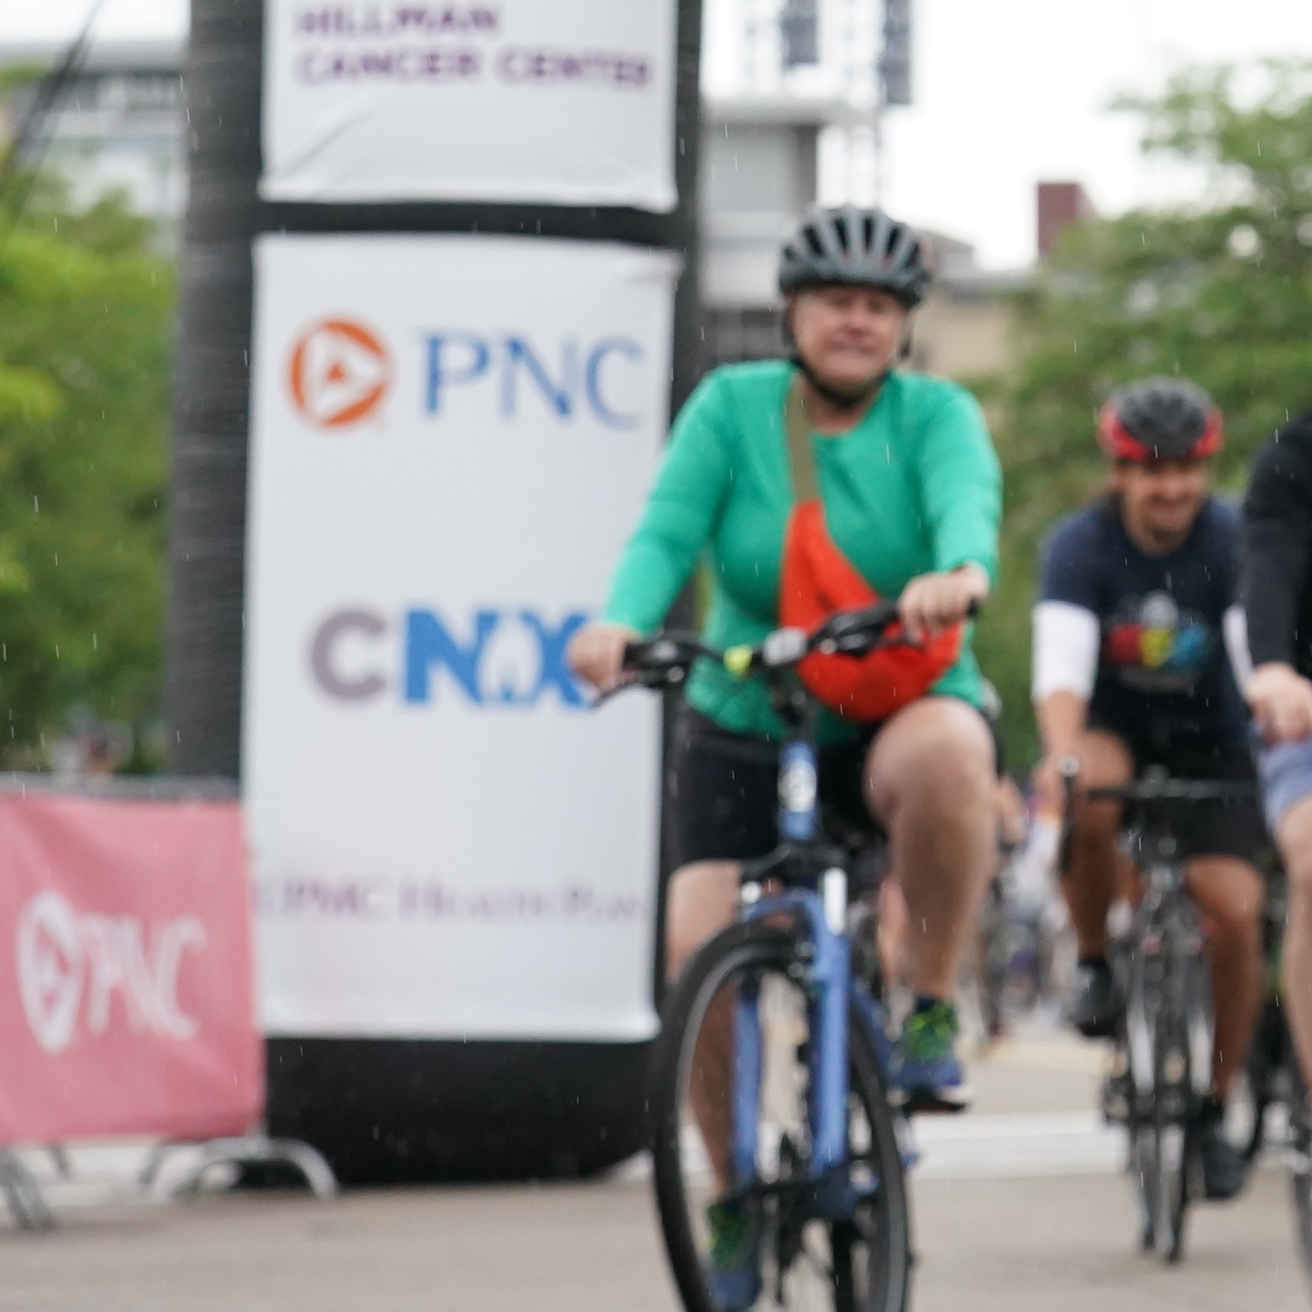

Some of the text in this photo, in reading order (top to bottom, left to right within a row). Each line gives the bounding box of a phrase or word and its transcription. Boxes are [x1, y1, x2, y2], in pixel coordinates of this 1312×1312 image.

[296, 4, 504, 37] HILLMAN
[296, 51, 482, 86] CANCER
[418, 330, 645, 430] PNC
[307, 606, 596, 710] CNX
